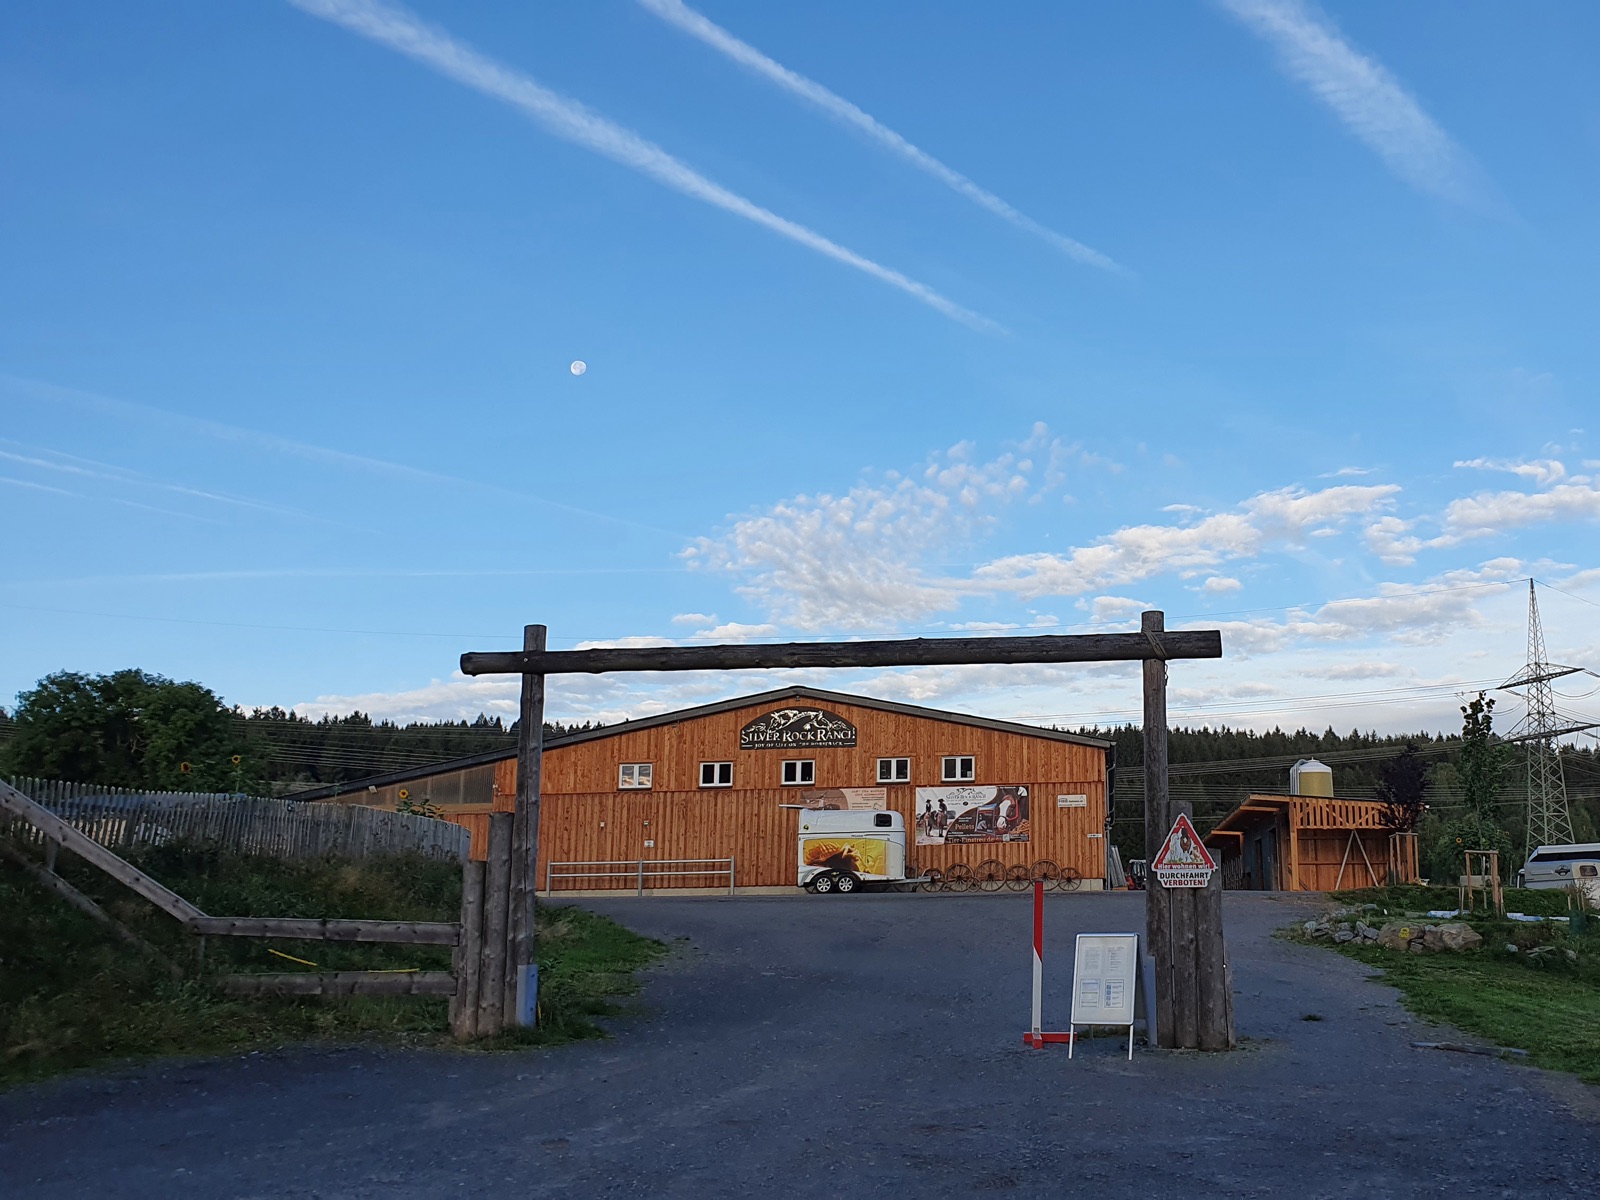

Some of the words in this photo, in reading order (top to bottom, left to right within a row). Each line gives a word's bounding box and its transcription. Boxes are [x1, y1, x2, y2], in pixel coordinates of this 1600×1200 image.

[741, 730, 780, 743] SILVER
[783, 730, 815, 742] ROCK
[816, 728, 855, 741] RANCH
